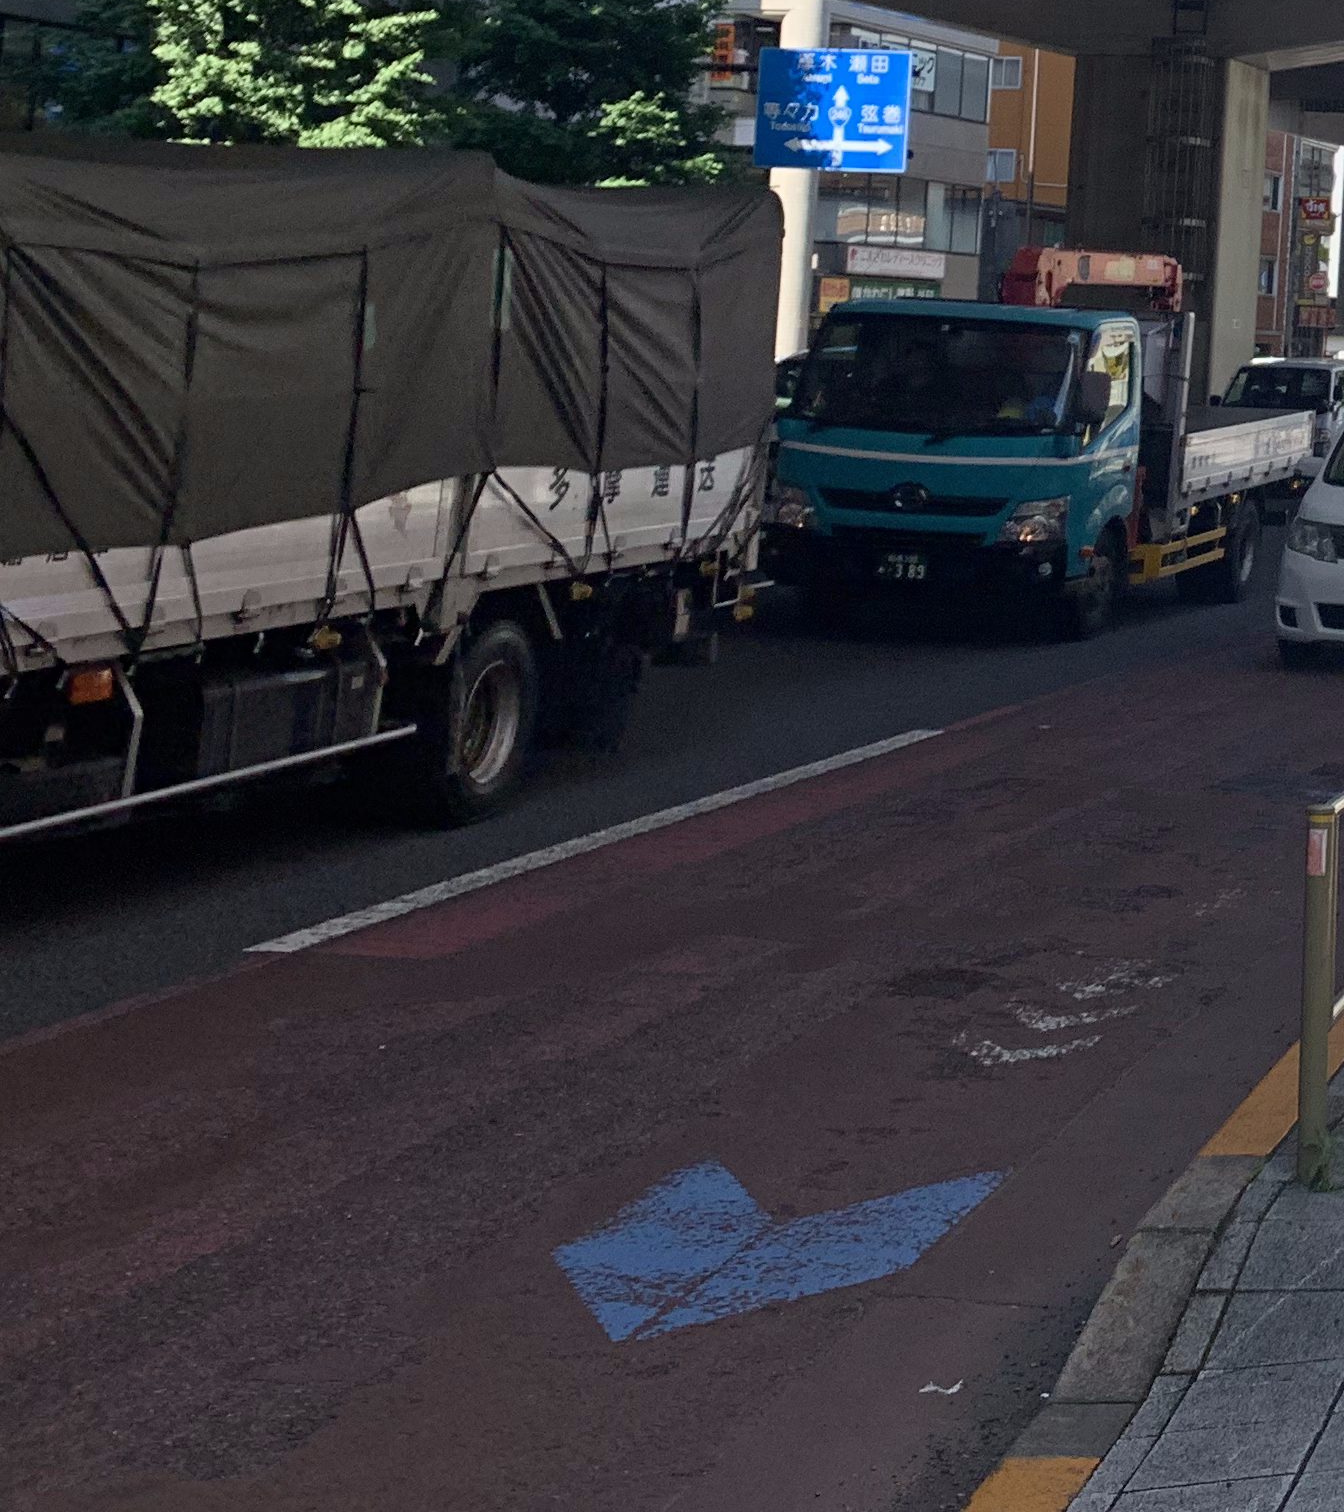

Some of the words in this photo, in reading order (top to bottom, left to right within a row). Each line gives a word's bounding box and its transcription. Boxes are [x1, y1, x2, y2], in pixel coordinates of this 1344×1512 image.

[848, 54, 890, 74] 瀬田
[763, 101, 820, 122] 等々力
[860, 104, 902, 124] 弦巻
